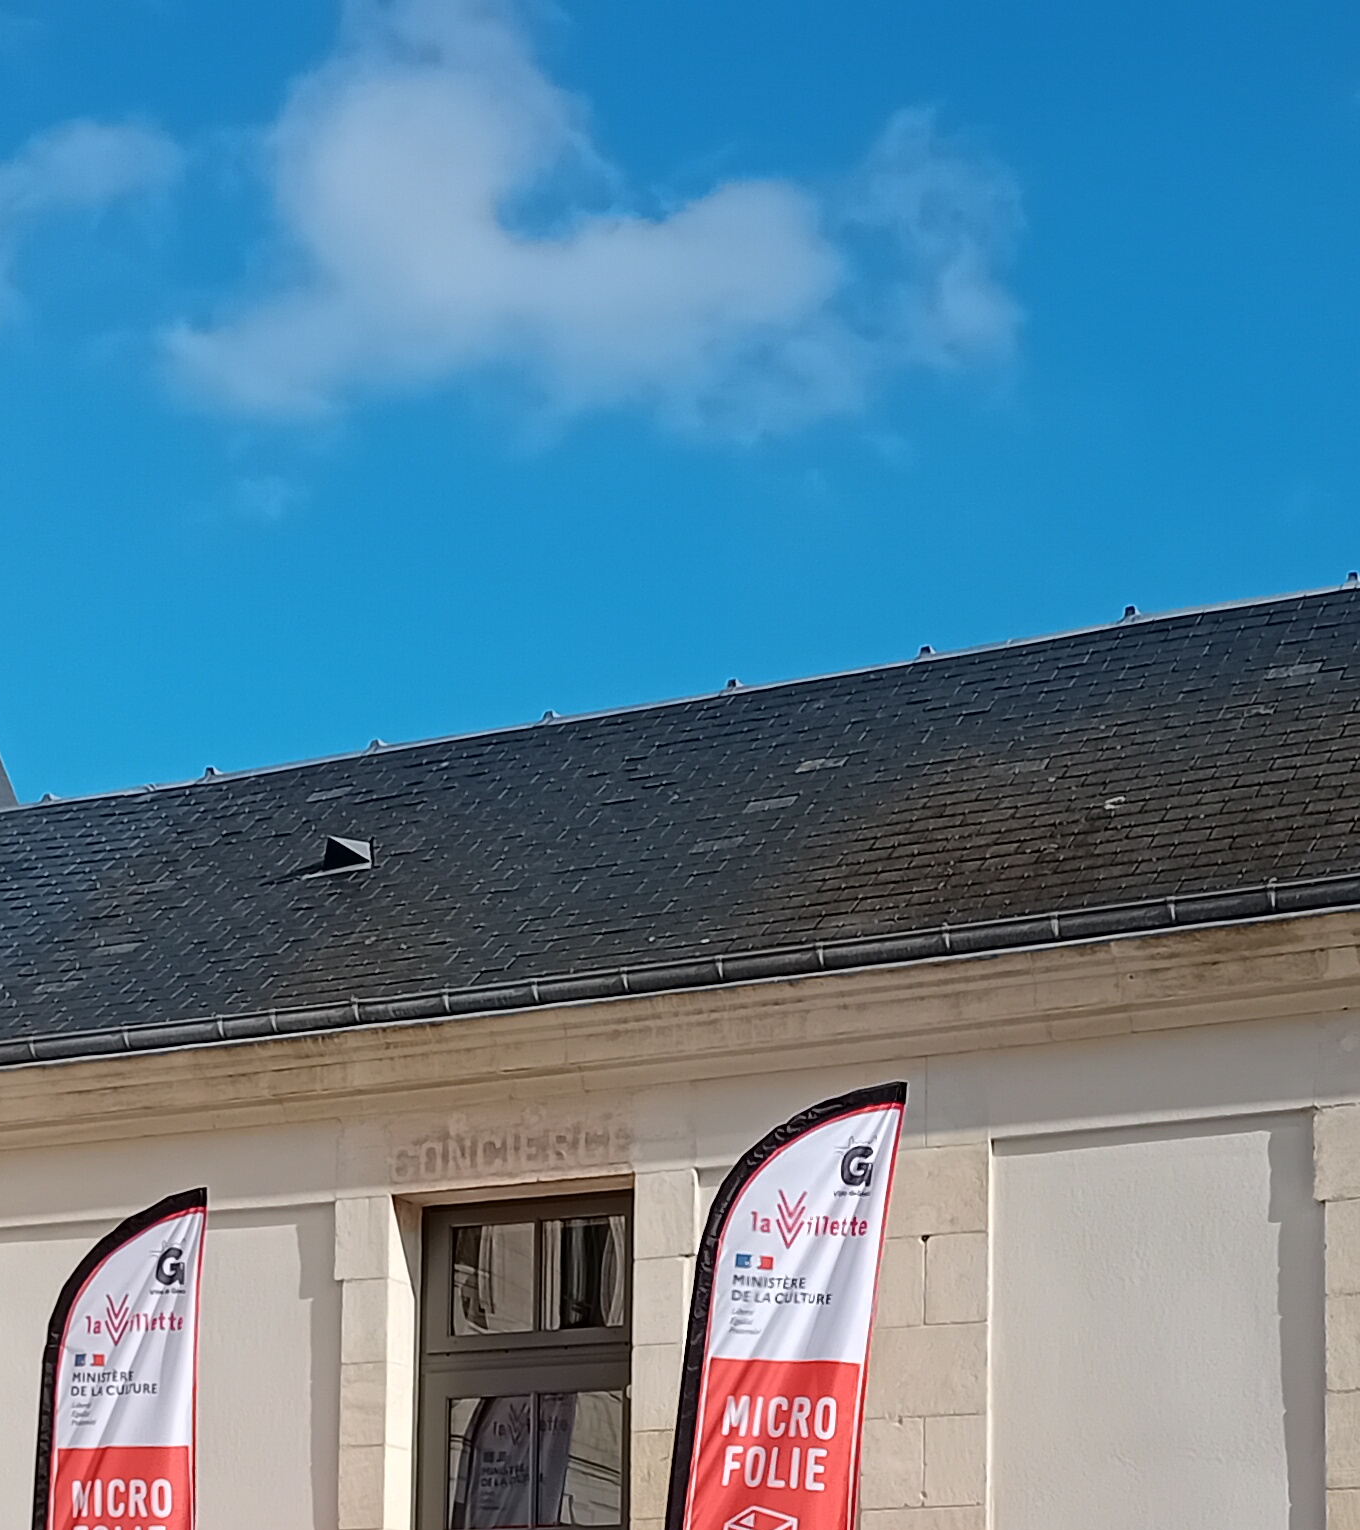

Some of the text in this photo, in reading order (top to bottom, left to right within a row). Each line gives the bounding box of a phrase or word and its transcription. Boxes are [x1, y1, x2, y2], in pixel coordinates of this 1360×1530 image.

[751, 1189, 868, 1249] la Villette
[731, 1289, 833, 1305] DE LA CULTURE
[732, 1273, 806, 1289] MINISTÈRE
[85, 1293, 183, 1346] la Villette
[71, 1383, 158, 1397] DE LA CULTURE
[72, 1368, 134, 1383] MINISTÈRE
[721, 1395, 837, 1440] MICRO
[721, 1445, 828, 1491] FOLIE
[72, 1478, 172, 1518] MICRO
